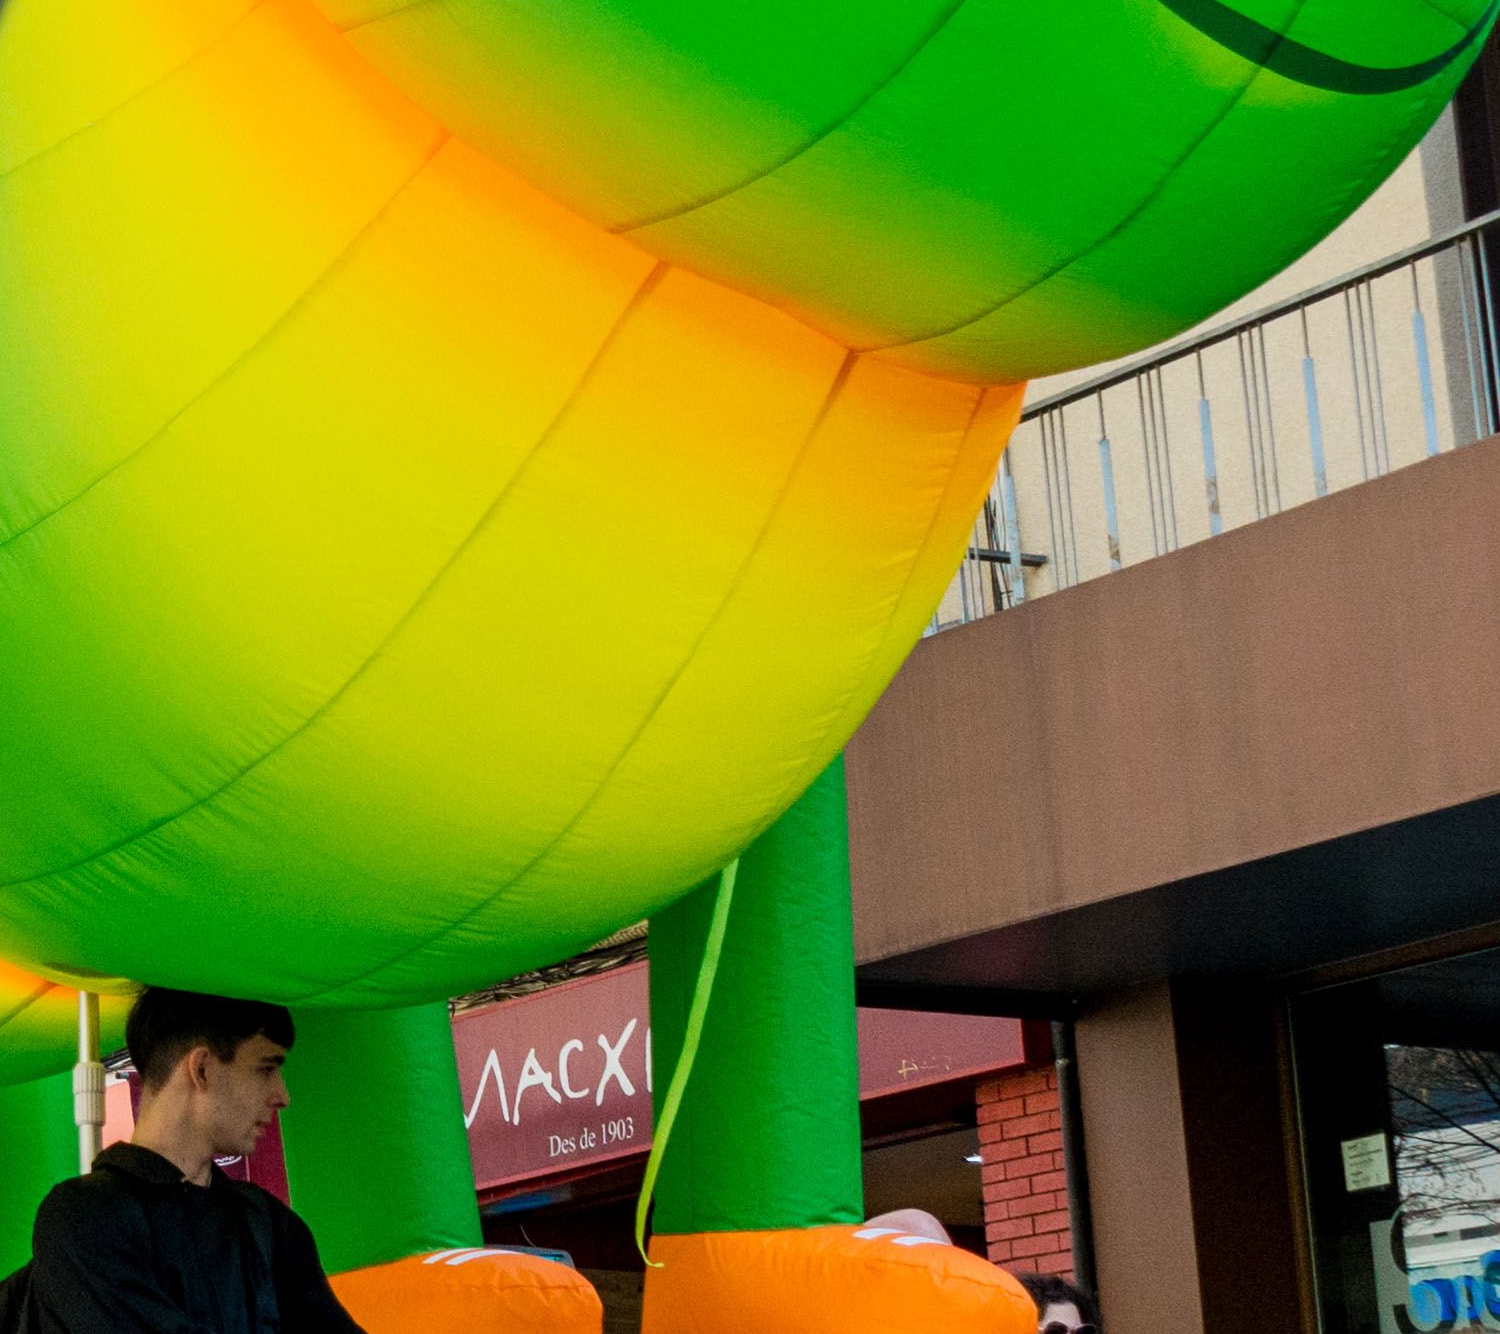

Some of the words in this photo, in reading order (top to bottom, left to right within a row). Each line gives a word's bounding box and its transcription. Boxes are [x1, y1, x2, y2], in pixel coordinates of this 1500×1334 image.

[464, 1018, 651, 1130] MACX
[549, 1135, 576, 1158] Des
[580, 1127, 596, 1150] de
[601, 1116, 634, 1145] 1903
